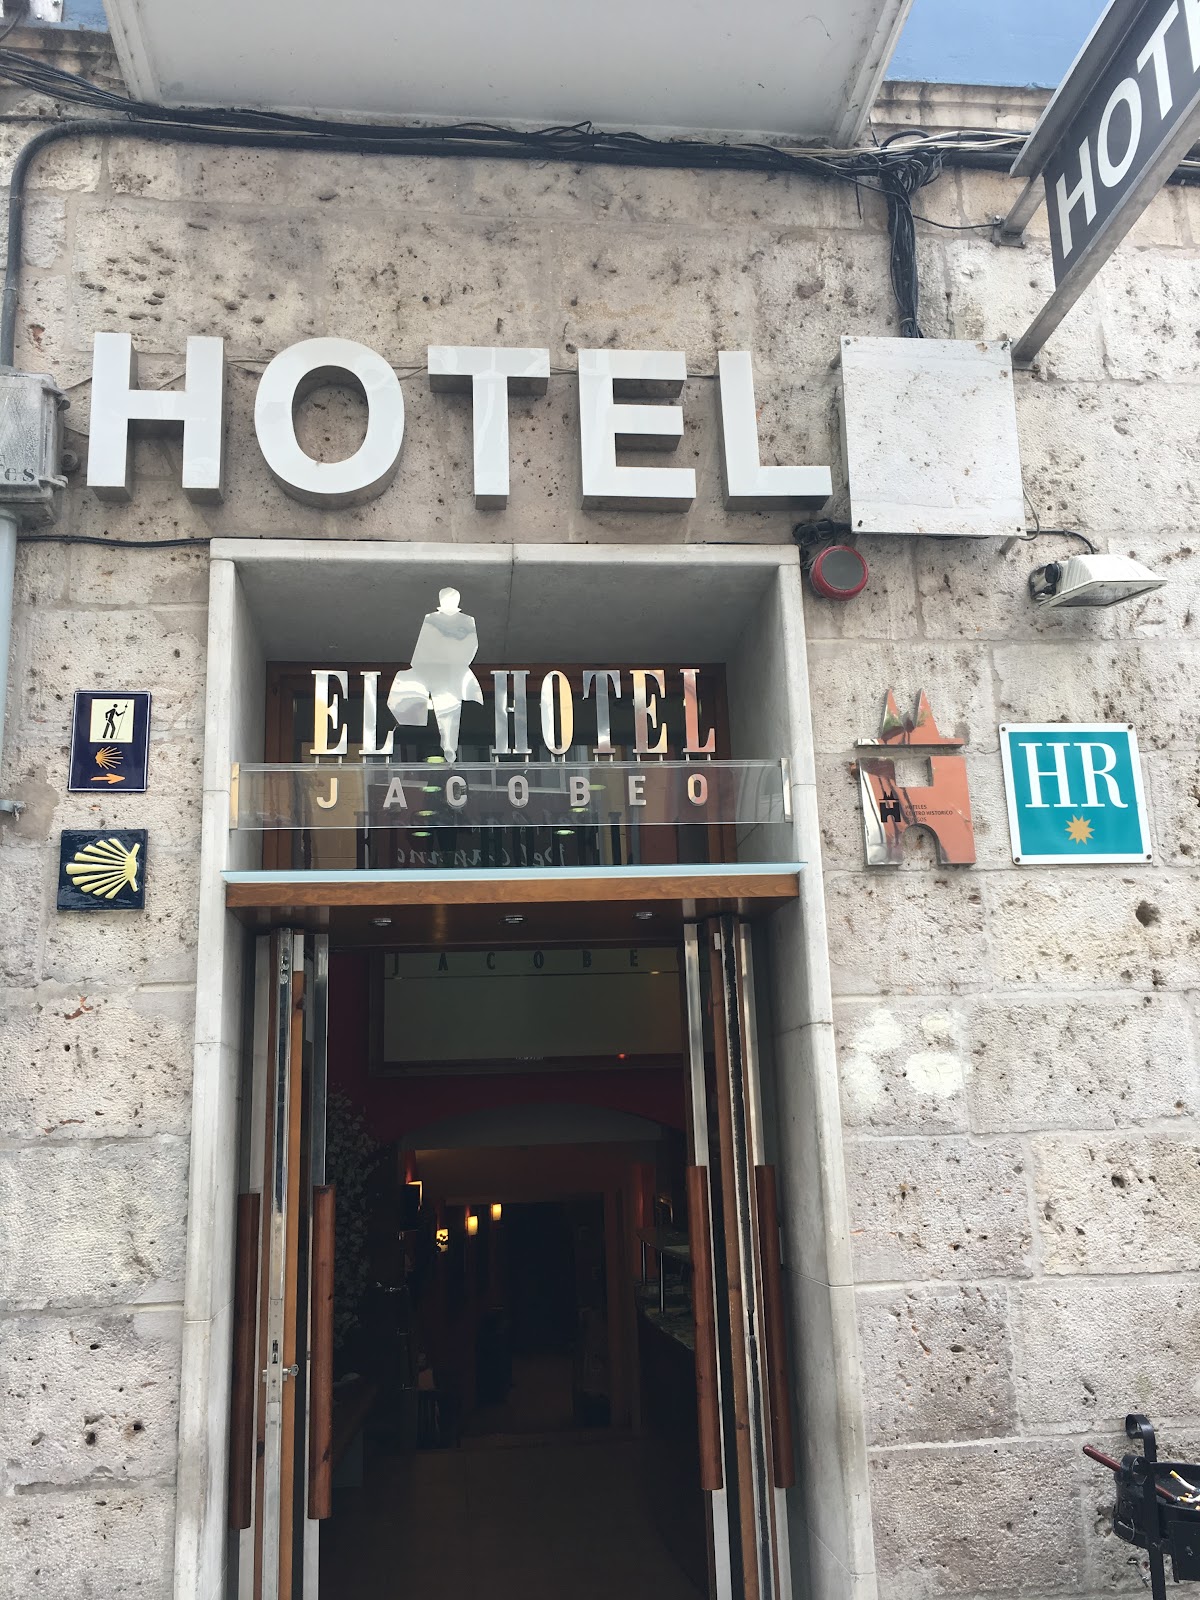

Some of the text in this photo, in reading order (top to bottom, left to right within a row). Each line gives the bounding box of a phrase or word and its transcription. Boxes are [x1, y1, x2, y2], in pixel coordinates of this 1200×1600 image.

[86, 332, 833, 508] HOTEL
[310, 668, 716, 755] EL HOTEL
[316, 774, 708, 809] JACOBEO
[1018, 742, 1128, 808] HR
[392, 949, 681, 976] JACOBE
